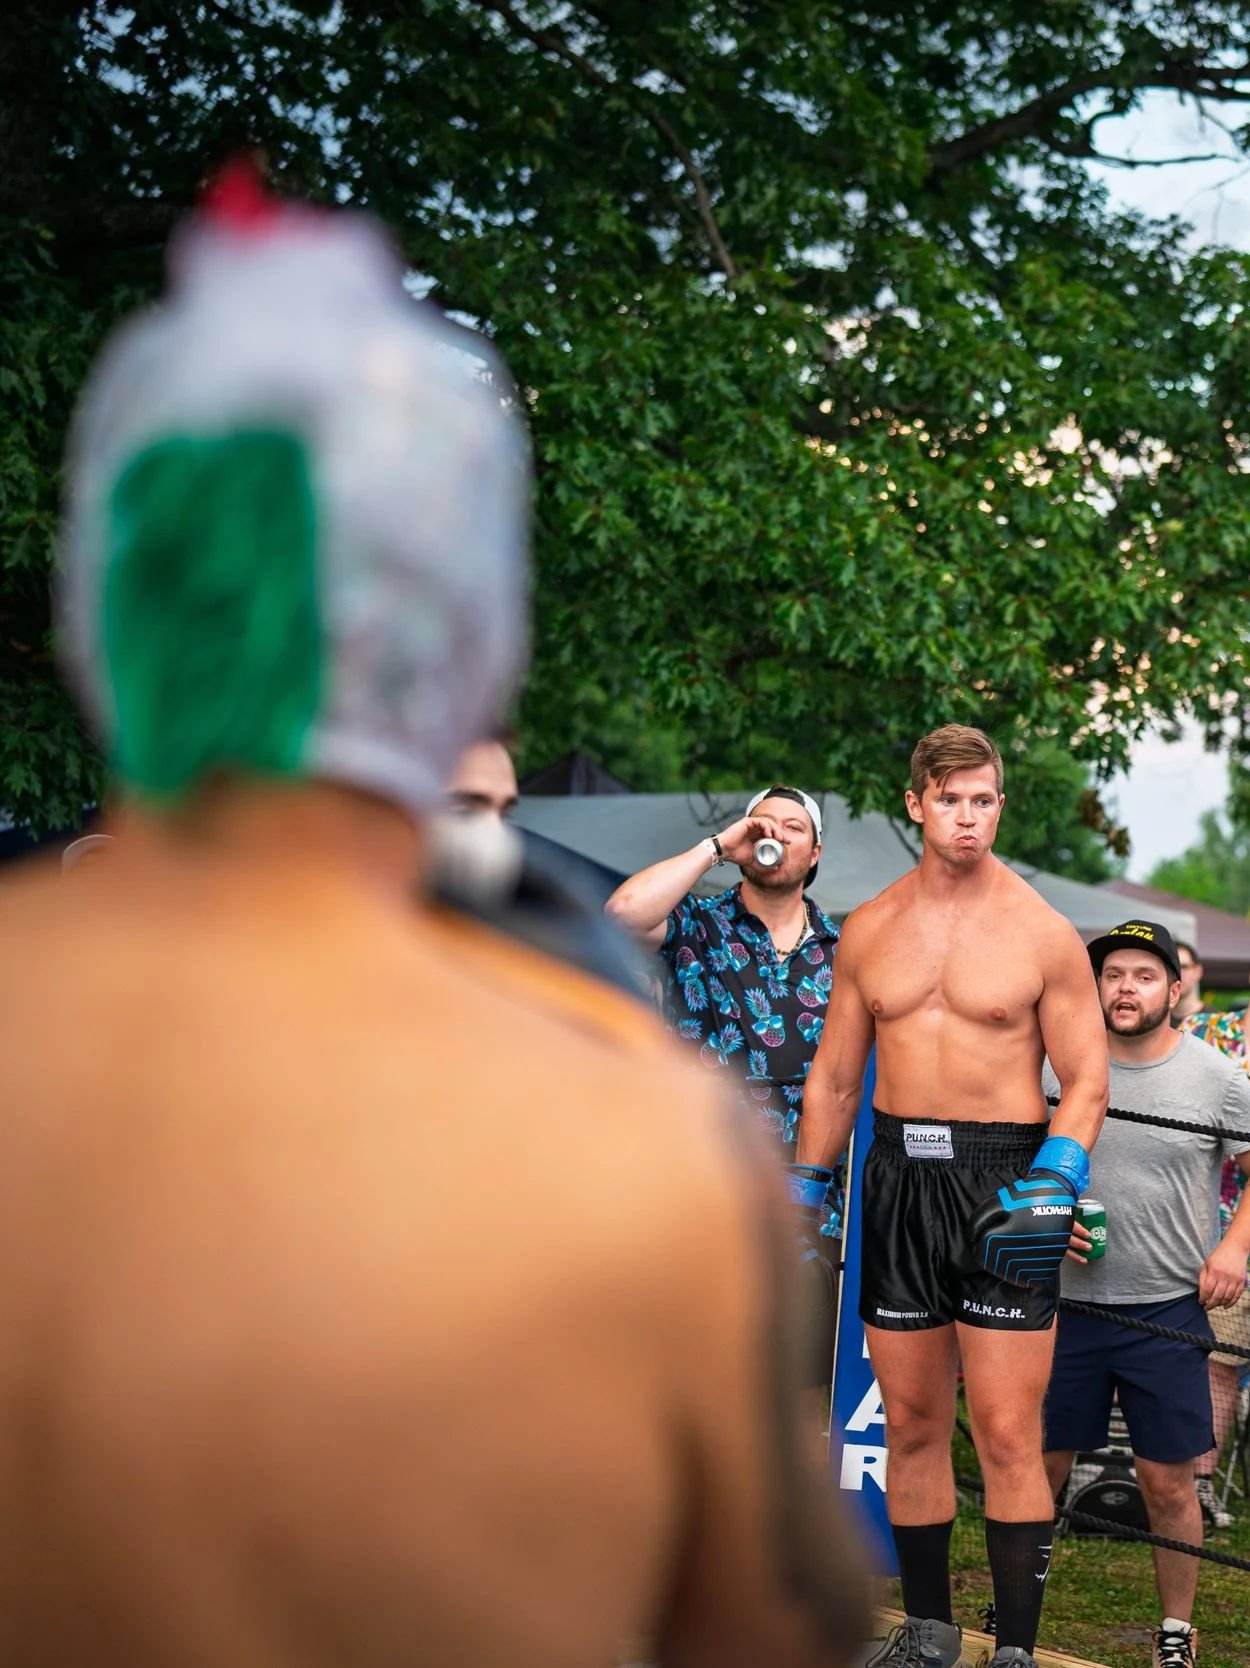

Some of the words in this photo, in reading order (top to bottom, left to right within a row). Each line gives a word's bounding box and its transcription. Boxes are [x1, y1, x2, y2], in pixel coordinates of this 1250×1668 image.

[1031, 1205, 1072, 1216] HYPNOTIK
[876, 1307, 901, 1319] MAXIMUM
[963, 1300, 1026, 1319] P.U.N.C.H.
